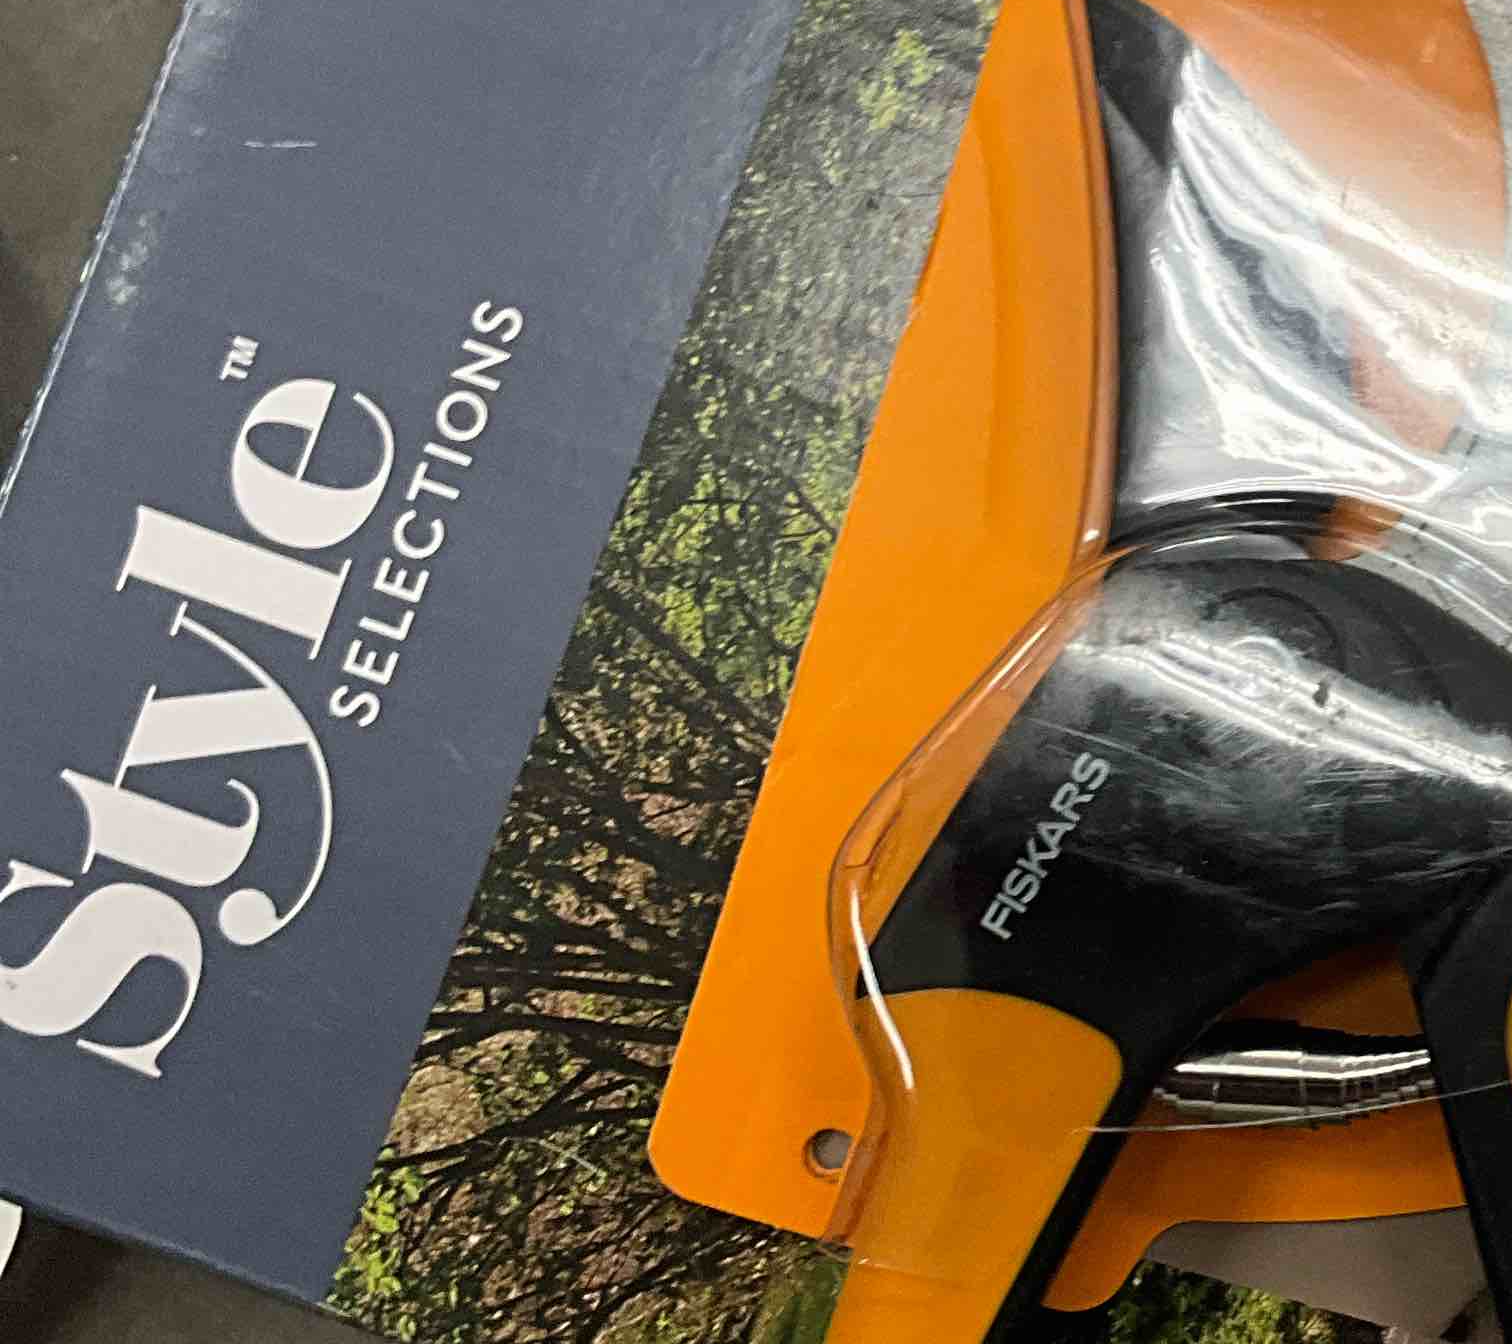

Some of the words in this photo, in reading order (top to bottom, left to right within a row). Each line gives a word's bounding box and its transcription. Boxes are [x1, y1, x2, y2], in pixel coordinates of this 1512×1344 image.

[0, 377, 394, 1080] Style
[329, 297, 525, 730] SELECTIONS
[979, 751, 1111, 940] FISKARS
